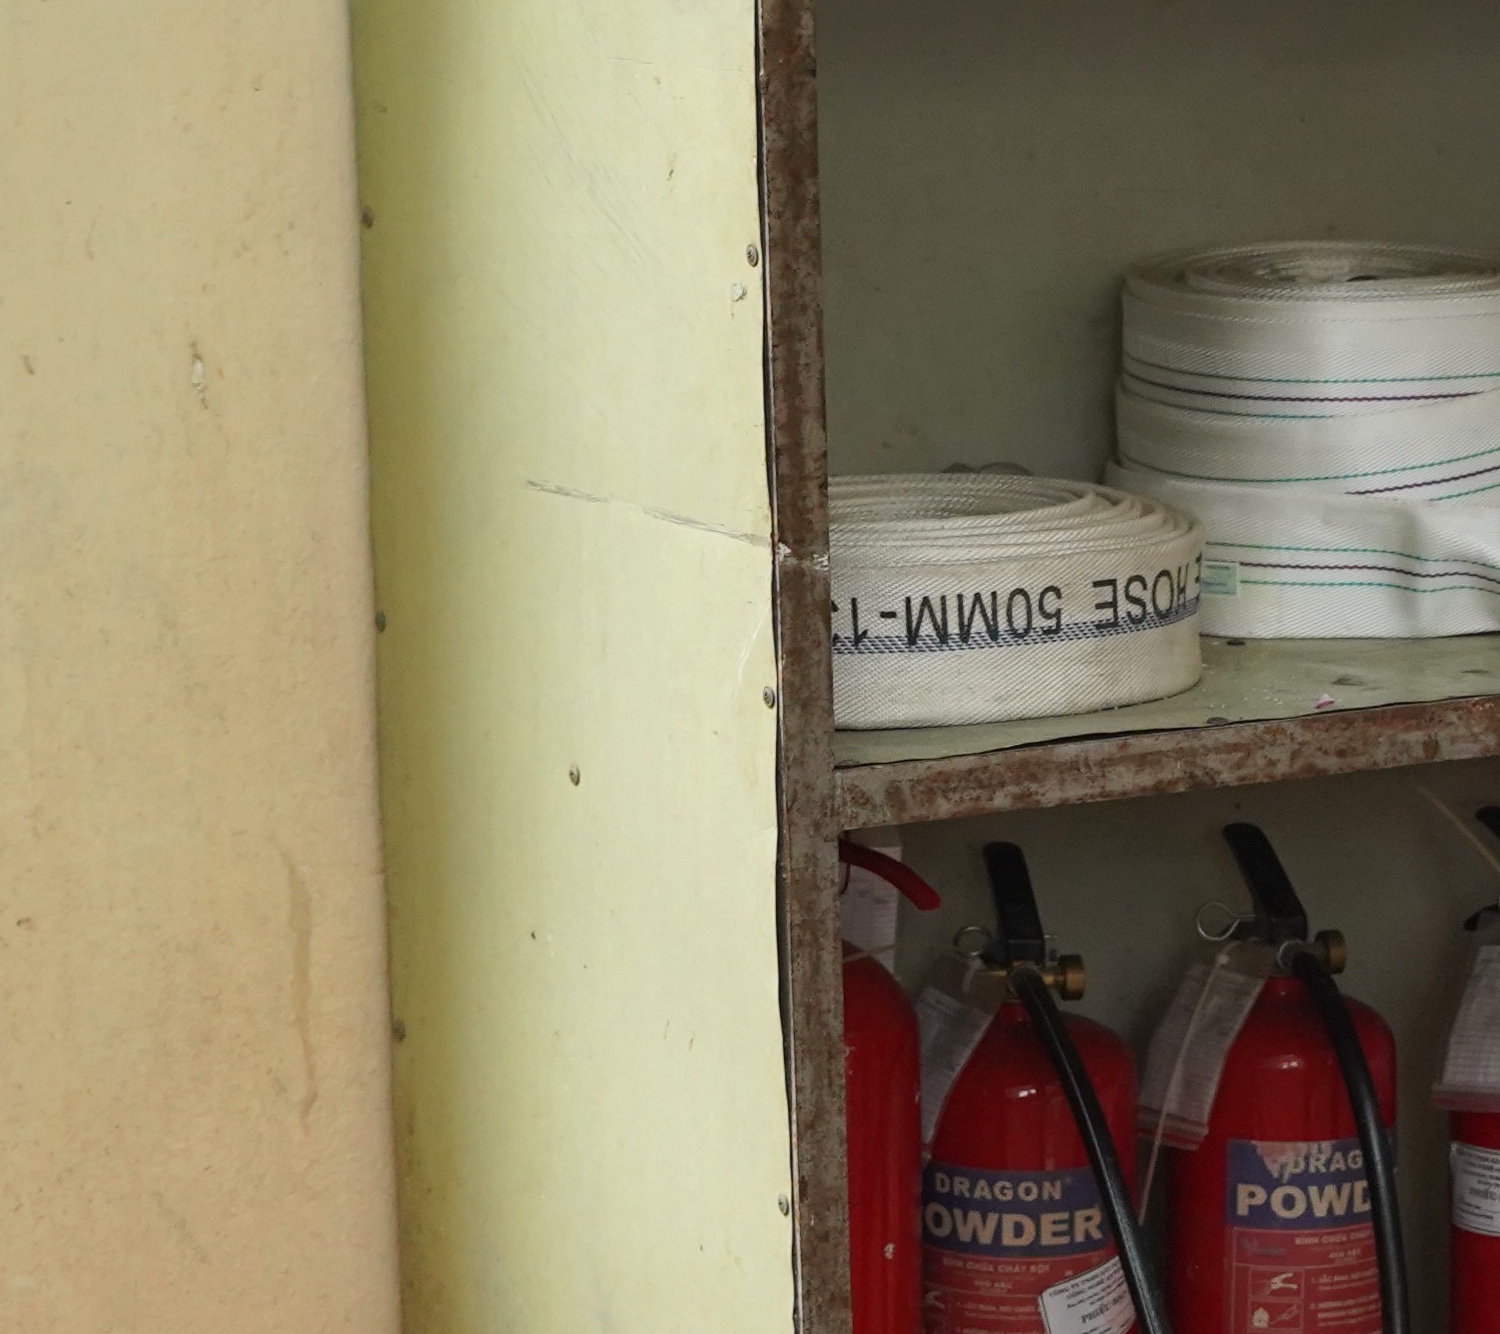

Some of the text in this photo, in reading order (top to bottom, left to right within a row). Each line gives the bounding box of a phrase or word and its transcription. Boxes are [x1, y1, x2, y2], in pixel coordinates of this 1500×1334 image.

[831, 585, 1063, 648] 50MM-1
[1092, 561, 1191, 630] HOSE
[1289, 1149, 1364, 1175] DRAG
[935, 1172, 1062, 1202] DRAGON
[1236, 1182, 1371, 1219] POWD
[925, 1201, 1104, 1248] OWDER
